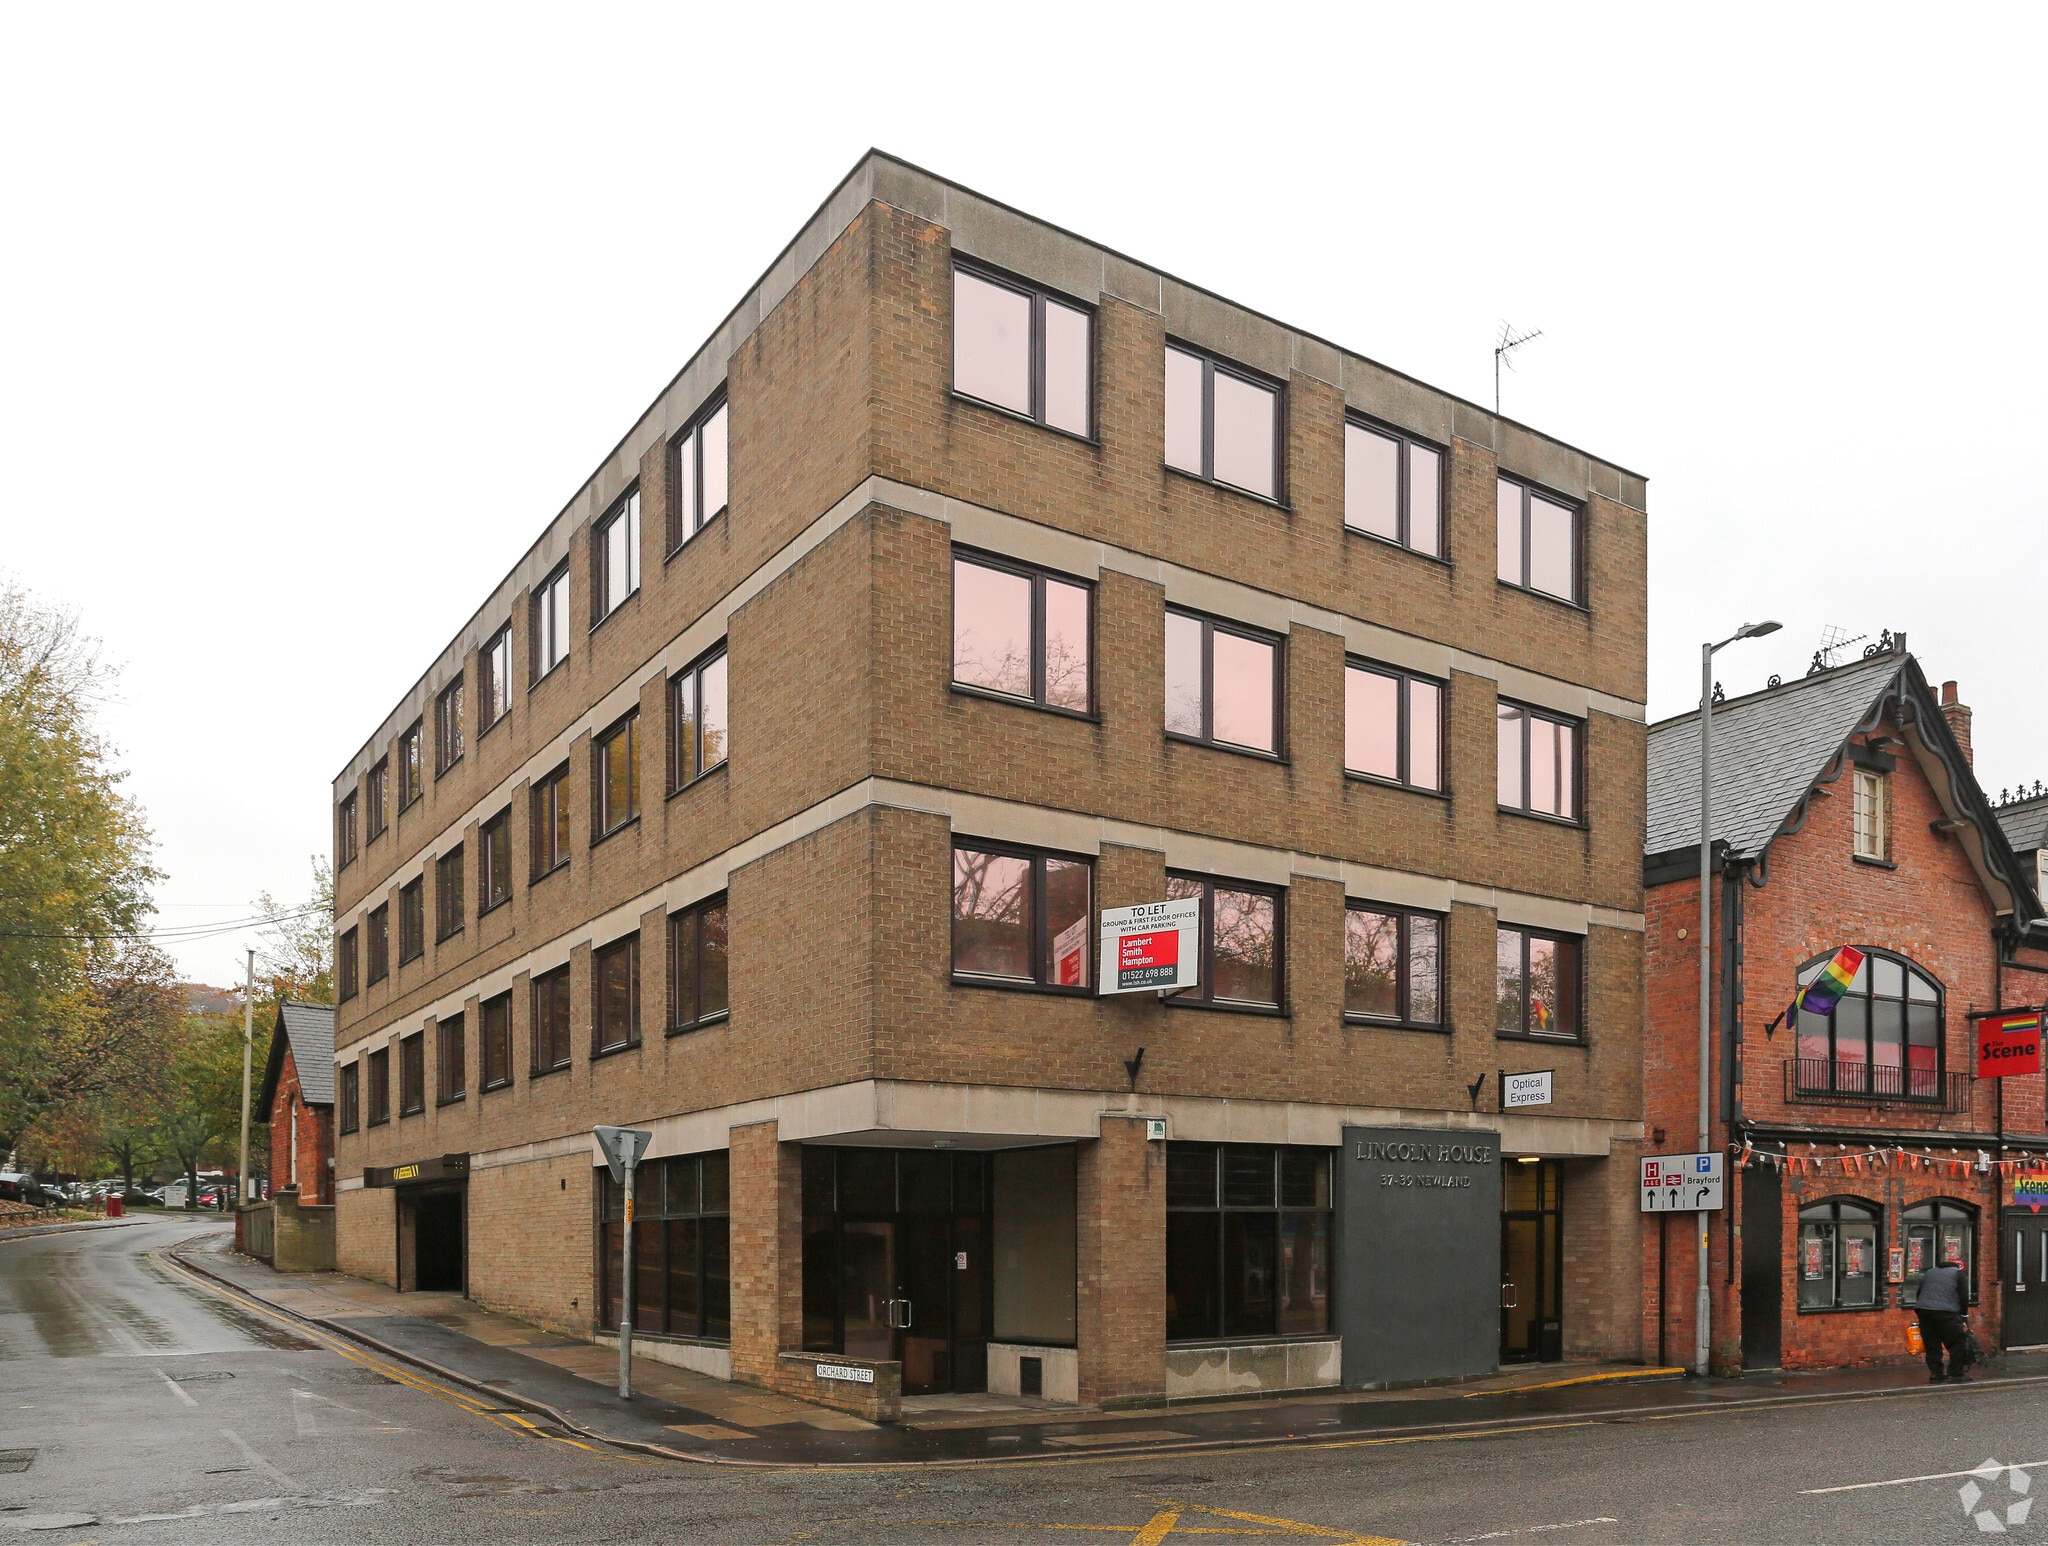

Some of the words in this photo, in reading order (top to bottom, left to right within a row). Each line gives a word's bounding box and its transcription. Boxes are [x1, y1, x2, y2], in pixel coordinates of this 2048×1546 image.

[1131, 907, 1145, 917] TO
[1148, 904, 1166, 915] LET
[1102, 920, 1127, 928] GROUND
[1134, 916, 1149, 924] FIRST
[1151, 914, 1171, 922] FLOOR
[1171, 911, 1196, 920] OFFICES
[1120, 925, 1137, 933] WITH
[1137, 923, 1150, 931] CAR
[1150, 921, 1176, 930] PARKING
[1122, 937, 1152, 948] Lambert
[1122, 947, 1142, 957] Smith
[1122, 956, 1153, 967] Hampton
[1122, 970, 1143, 980] 01522
[1145, 968, 1158, 978] 698
[1159, 967, 1173, 977] 888
[1982, 1042, 2035, 1060] Scene
[1512, 1077, 1543, 1091] Optical
[1510, 1091, 1545, 1104] Express
[1356, 1141, 1432, 1162] LINCOLN
[1437, 1144, 1492, 1164] HOUSE
[1647, 1164, 1657, 1176] H
[1699, 1158, 1709, 1171] P
[1380, 1174, 1413, 1187] 37-39
[1417, 1174, 1471, 1188] NEWLAND
[1687, 1176, 1720, 1185] Brayford
[818, 1366, 848, 1378] ORCHARD
[850, 1369, 872, 1381] STREET
